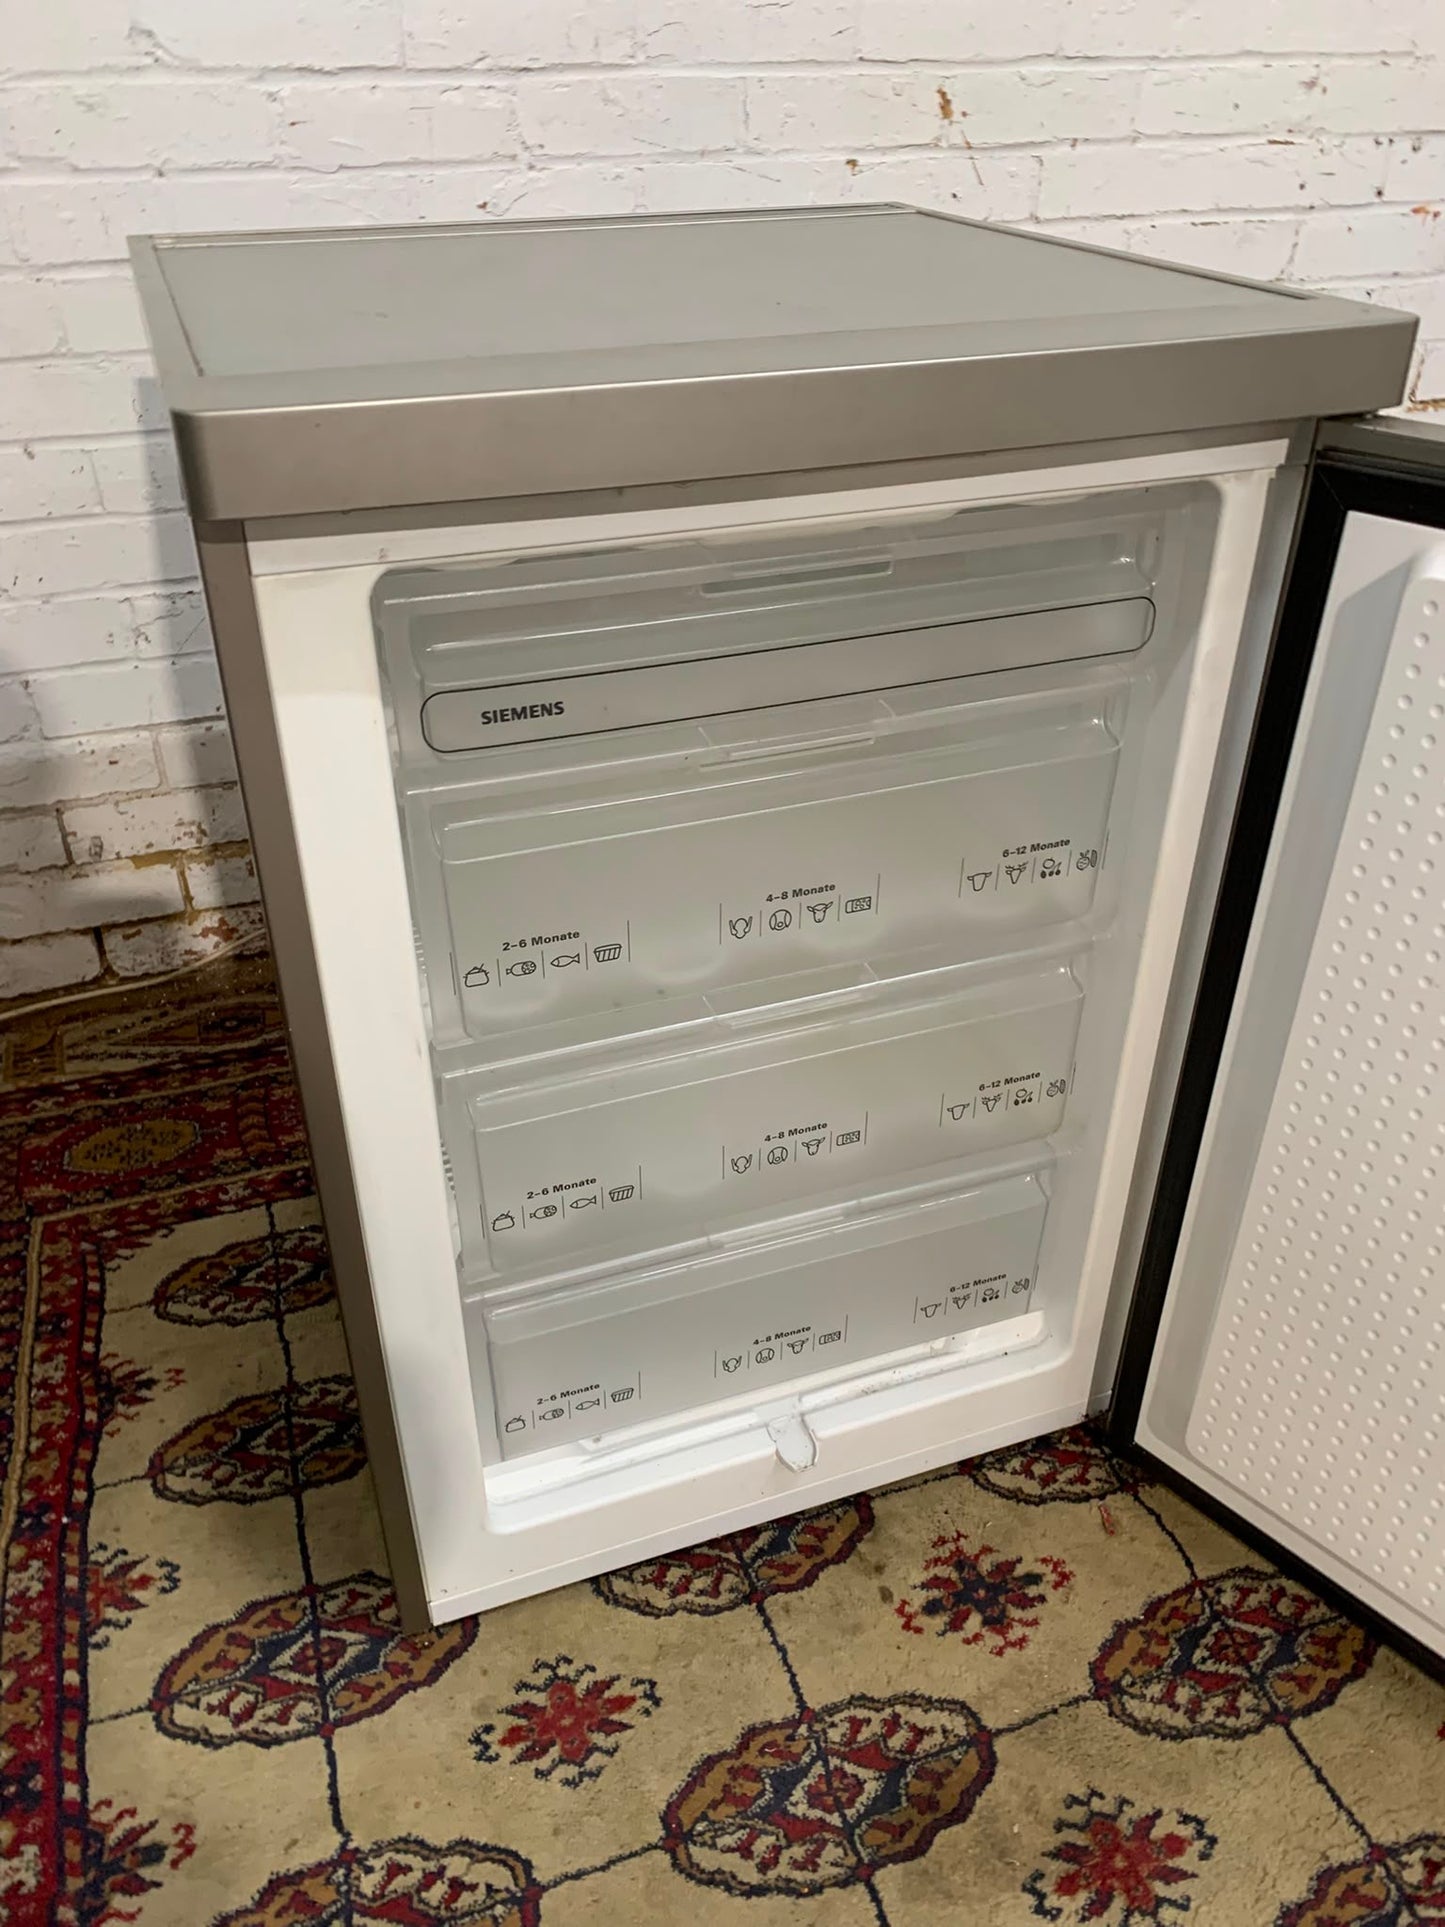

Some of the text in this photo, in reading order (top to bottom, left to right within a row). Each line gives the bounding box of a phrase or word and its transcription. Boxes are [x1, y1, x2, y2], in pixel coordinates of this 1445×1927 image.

[480, 701, 565, 725] SIEMENS
[1030, 839, 1071, 853] Monate
[765, 884, 836, 902] 4-8 Monate
[502, 931, 580, 951] 2-6 Monate
[1003, 1072, 1041, 1085] Monate
[788, 1122, 828, 1136] Monate
[552, 1178, 597, 1193] Monate
[972, 1274, 1007, 1287] Monate
[774, 1326, 811, 1340] Monate
[560, 1384, 600, 1398] Monate
